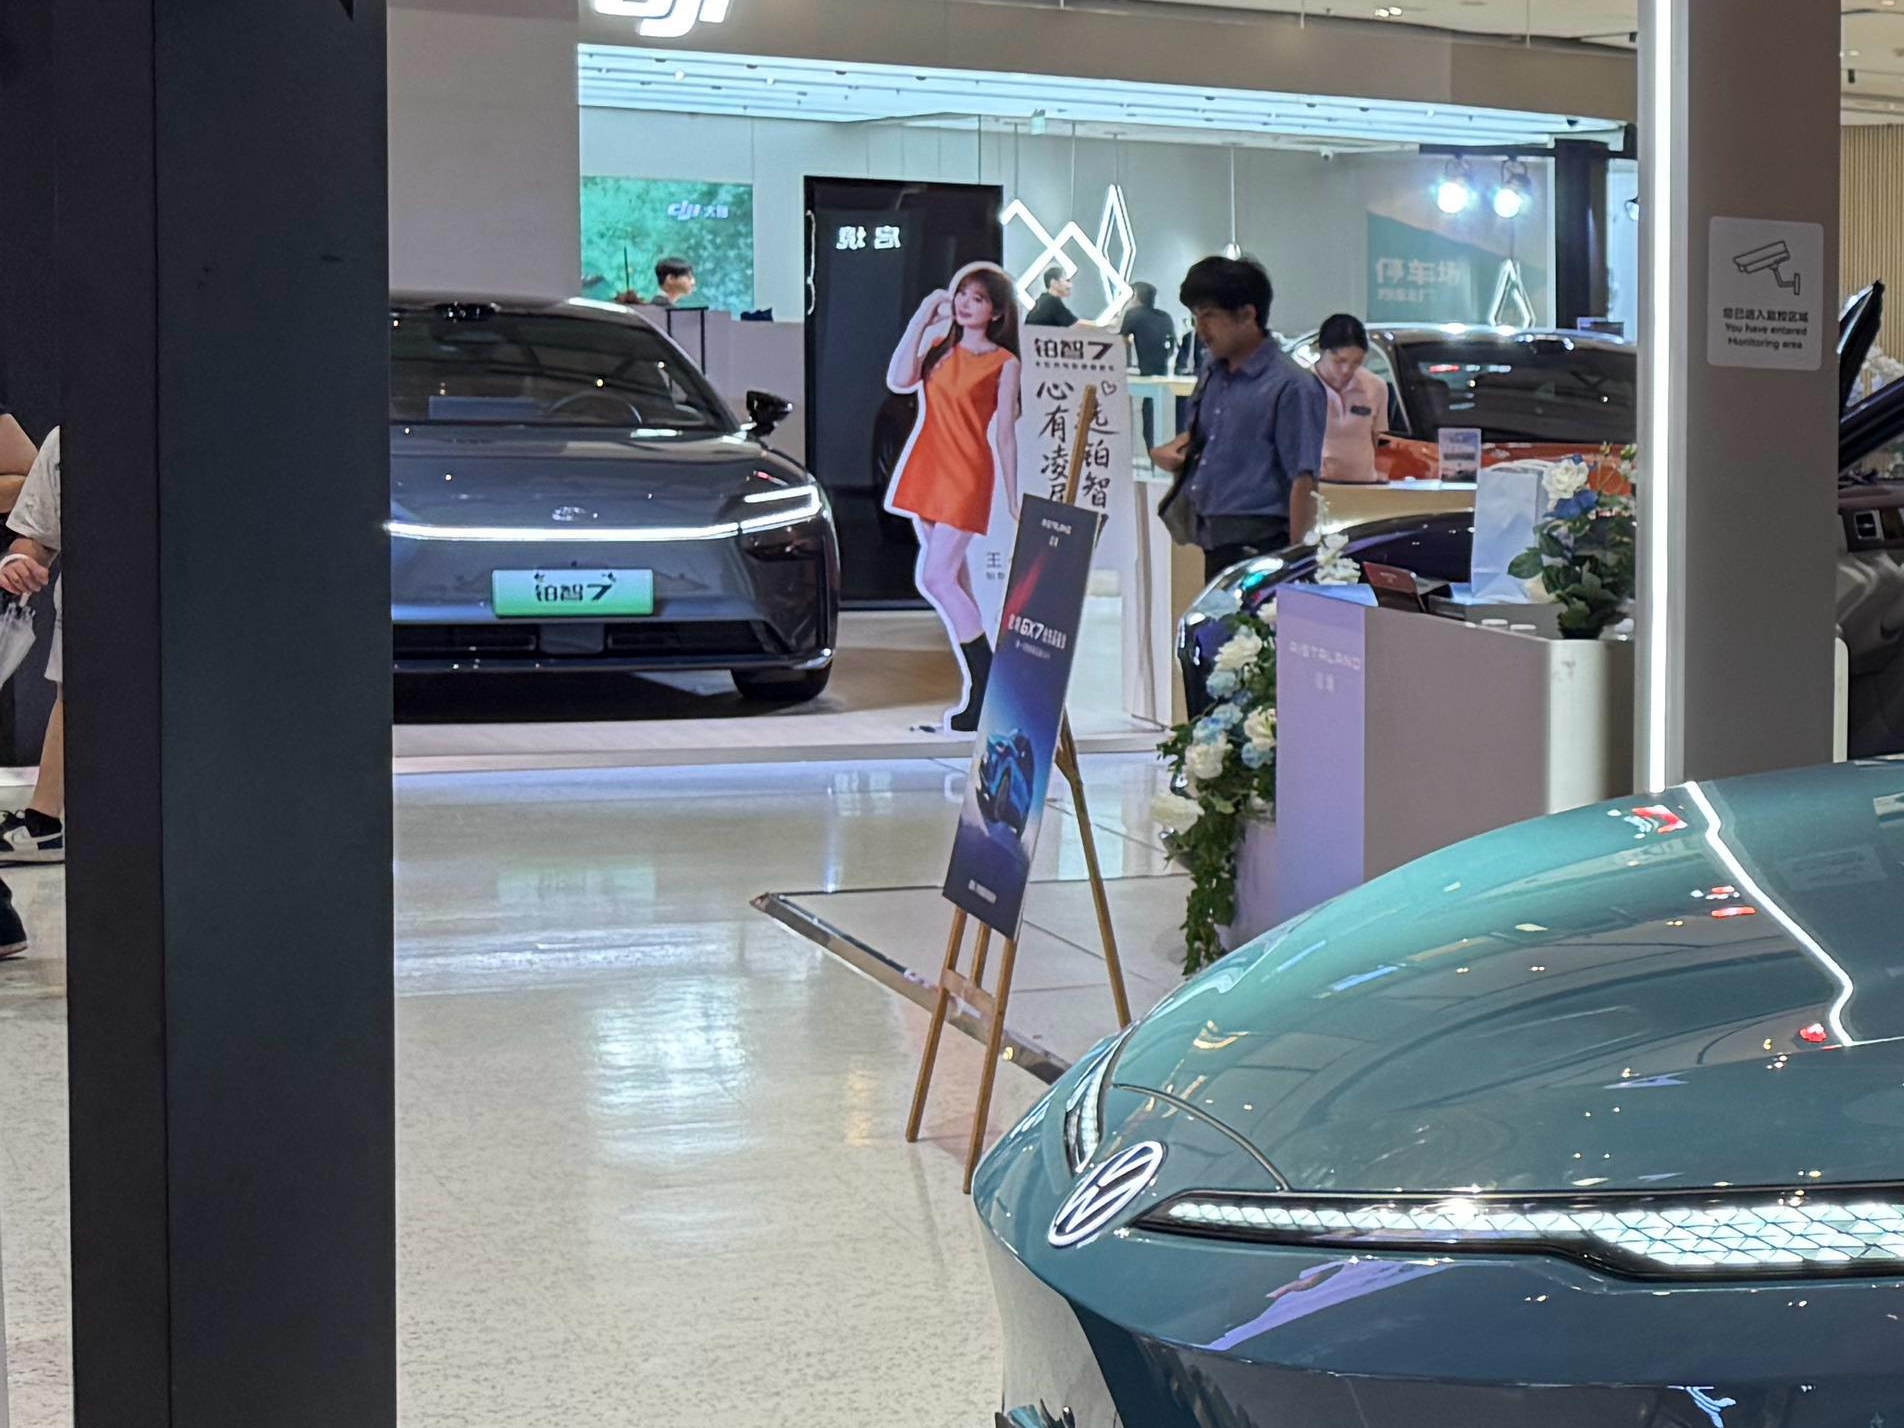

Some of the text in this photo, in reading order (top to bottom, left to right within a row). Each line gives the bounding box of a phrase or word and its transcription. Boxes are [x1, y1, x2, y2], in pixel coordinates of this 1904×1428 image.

[1722, 307, 1808, 323] 您已进入监控区域
[1725, 323, 1808, 336] You have entered
[1728, 336, 1803, 351] Monitoring area
